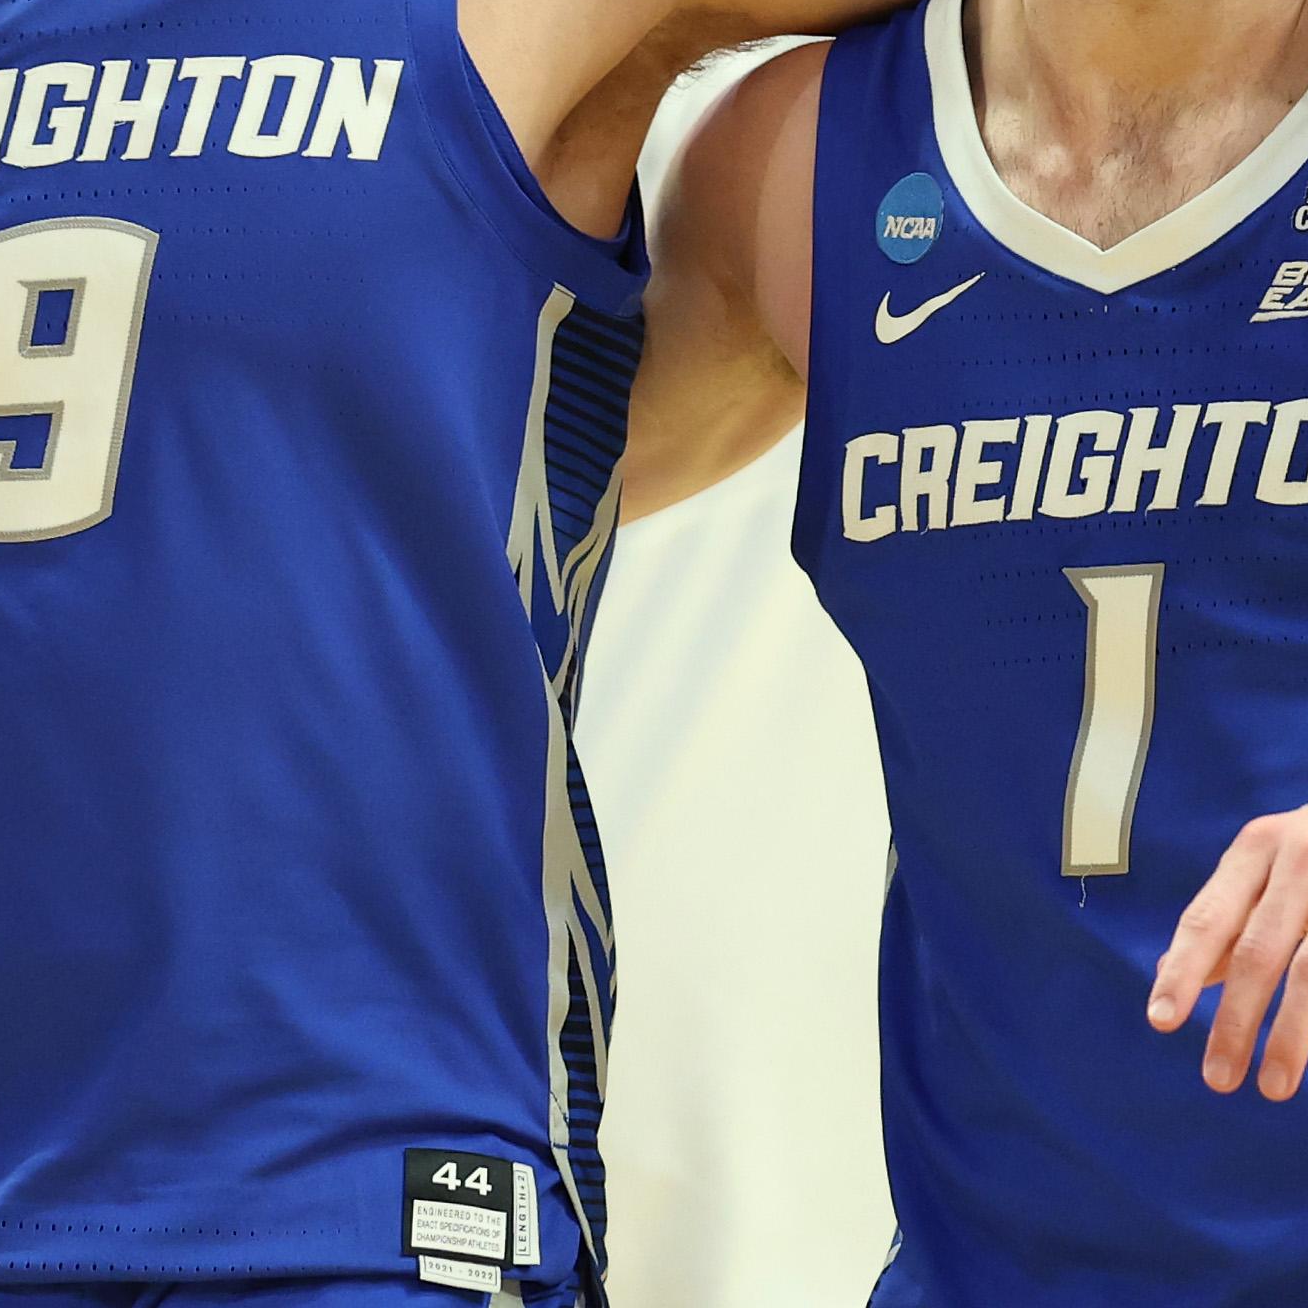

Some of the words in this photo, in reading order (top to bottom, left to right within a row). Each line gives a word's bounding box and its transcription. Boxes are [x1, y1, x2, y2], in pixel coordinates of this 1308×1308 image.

[883, 215, 937, 239] NCAA
[1060, 562, 1166, 877] 1
[432, 1161, 493, 1196] 44
[417, 1205, 471, 1220] ENGINEERED
[474, 1212, 484, 1223] TO
[428, 1261, 453, 1273] 2021
[468, 1268, 493, 1280] 2022
